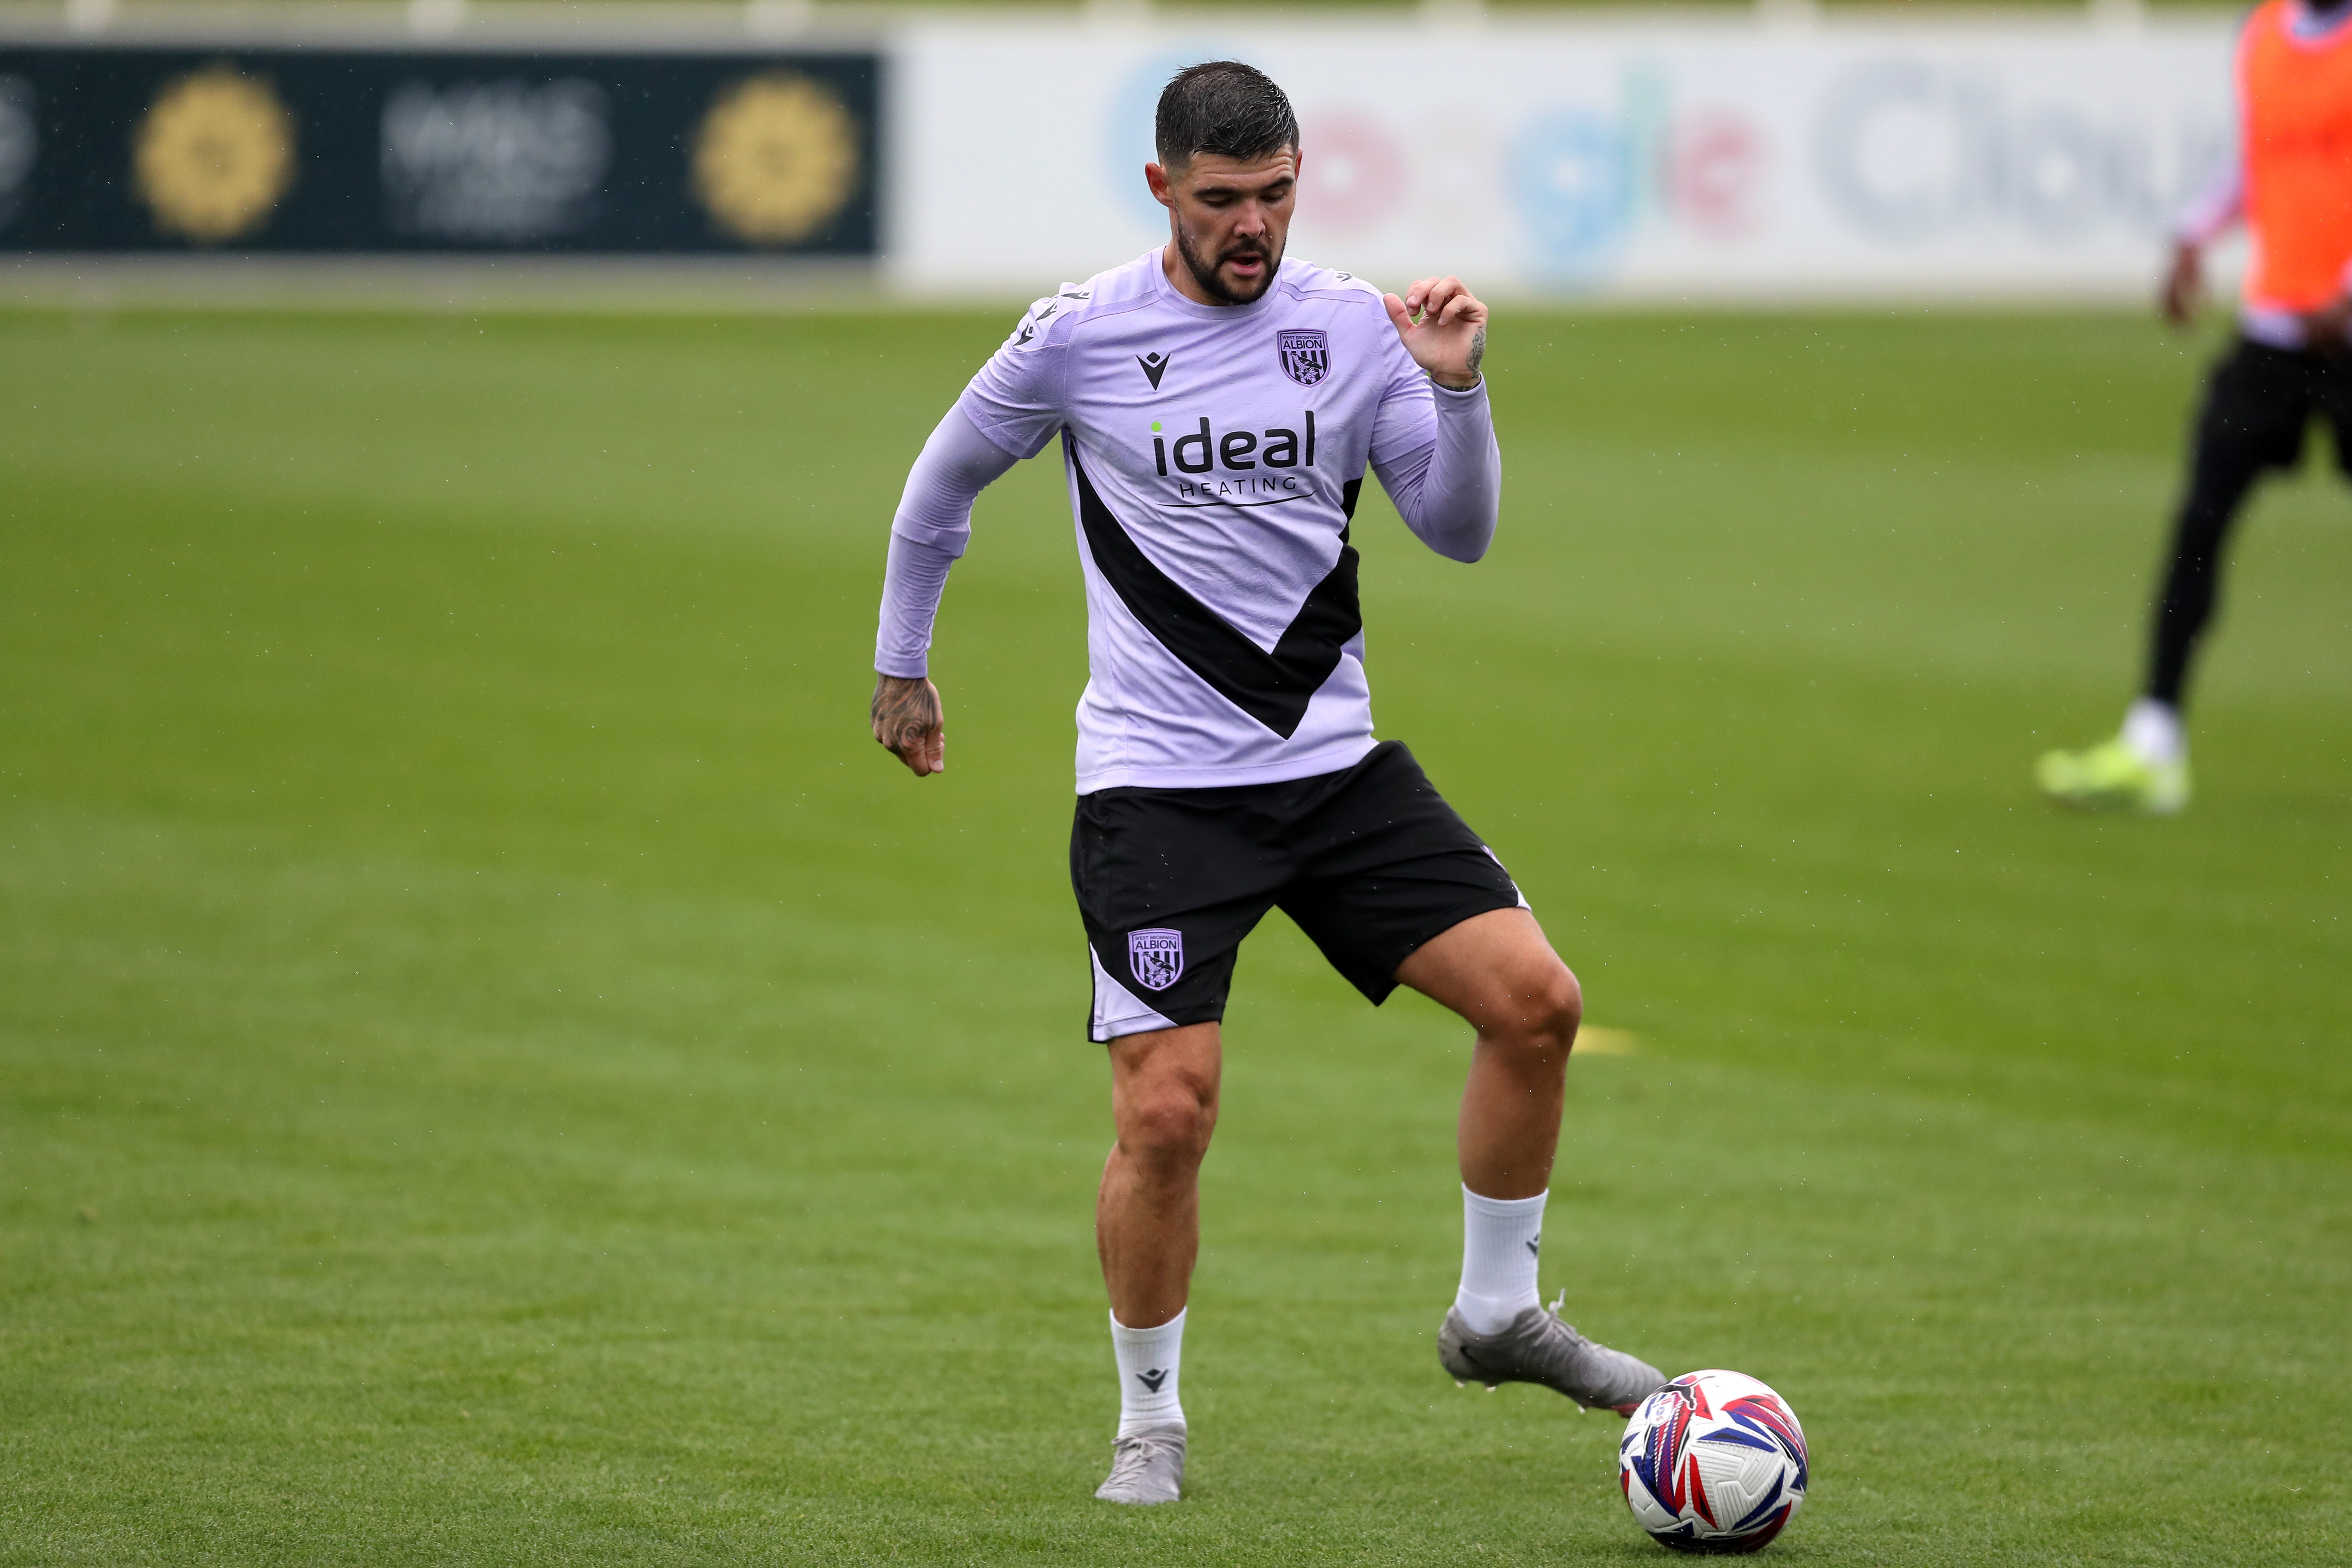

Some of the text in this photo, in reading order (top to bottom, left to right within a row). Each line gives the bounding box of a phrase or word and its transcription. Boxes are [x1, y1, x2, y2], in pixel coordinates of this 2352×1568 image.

[1105, 49, 1769, 284] oogle
[1283, 340, 1323, 349] ALBION
[1151, 410, 1316, 476] ideal
[1179, 476, 1296, 498] HEATING
[1135, 940, 1177, 949] ALBION
